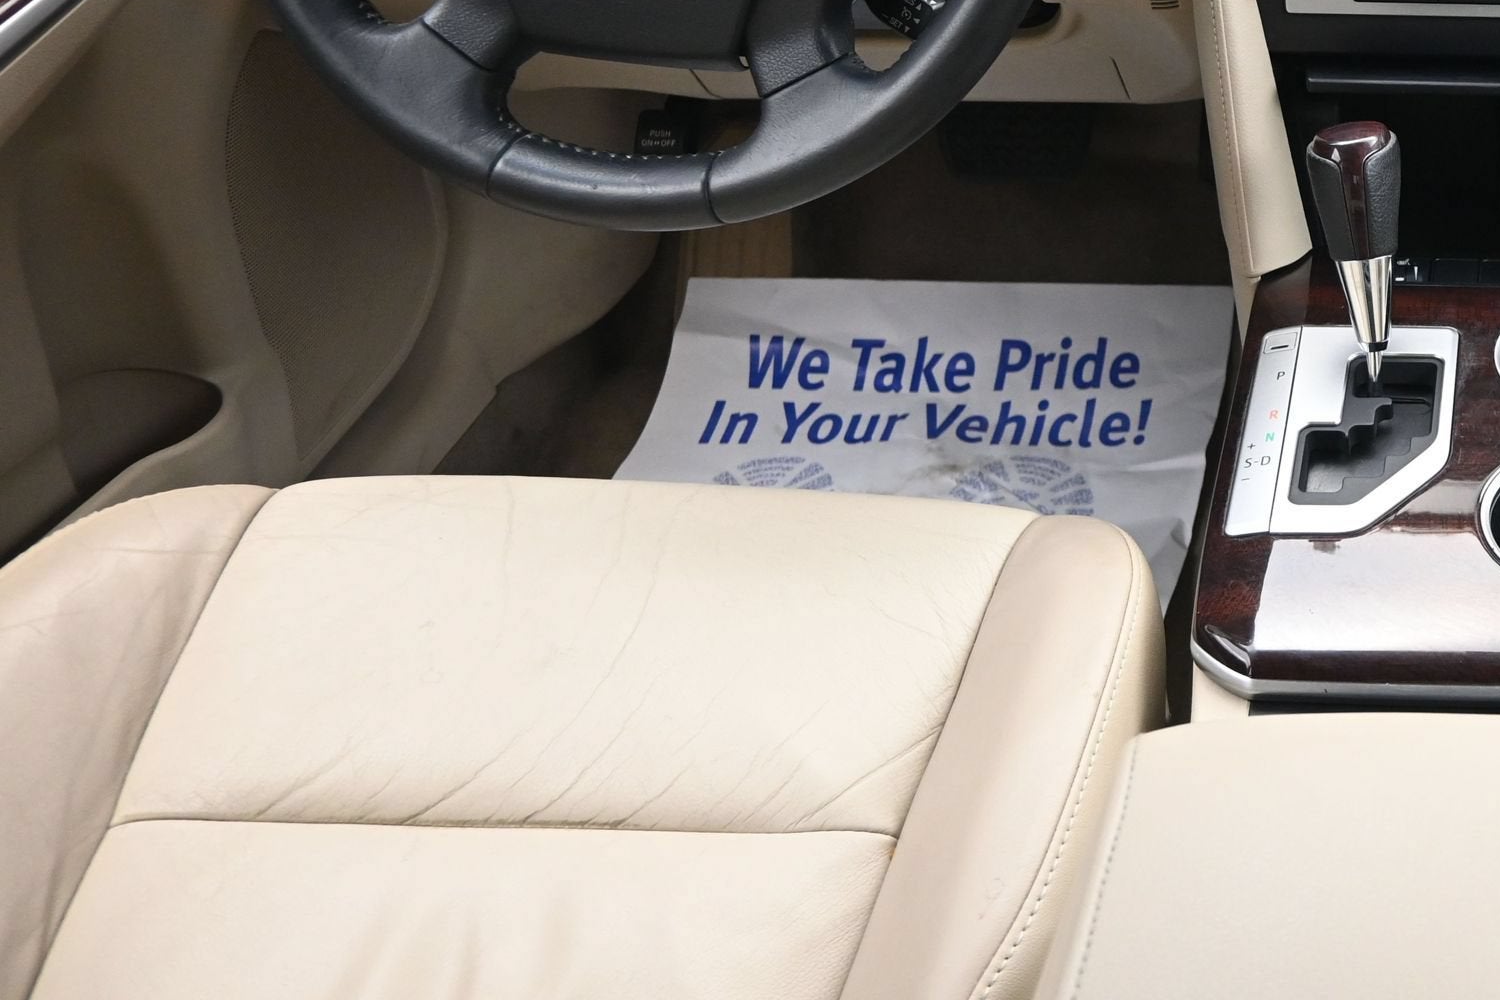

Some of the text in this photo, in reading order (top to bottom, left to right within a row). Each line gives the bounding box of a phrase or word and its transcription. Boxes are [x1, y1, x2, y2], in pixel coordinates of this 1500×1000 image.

[889, 16, 904, 29] SET
[649, 128, 671, 138] PUSH
[661, 139, 676, 147] OFF
[747, 334, 1141, 394] We Take Pride
[1276, 370, 1287, 381] P
[1268, 409, 1279, 420] R
[698, 397, 1153, 448] In Your Vehicle!
[1264, 432, 1276, 442] N
